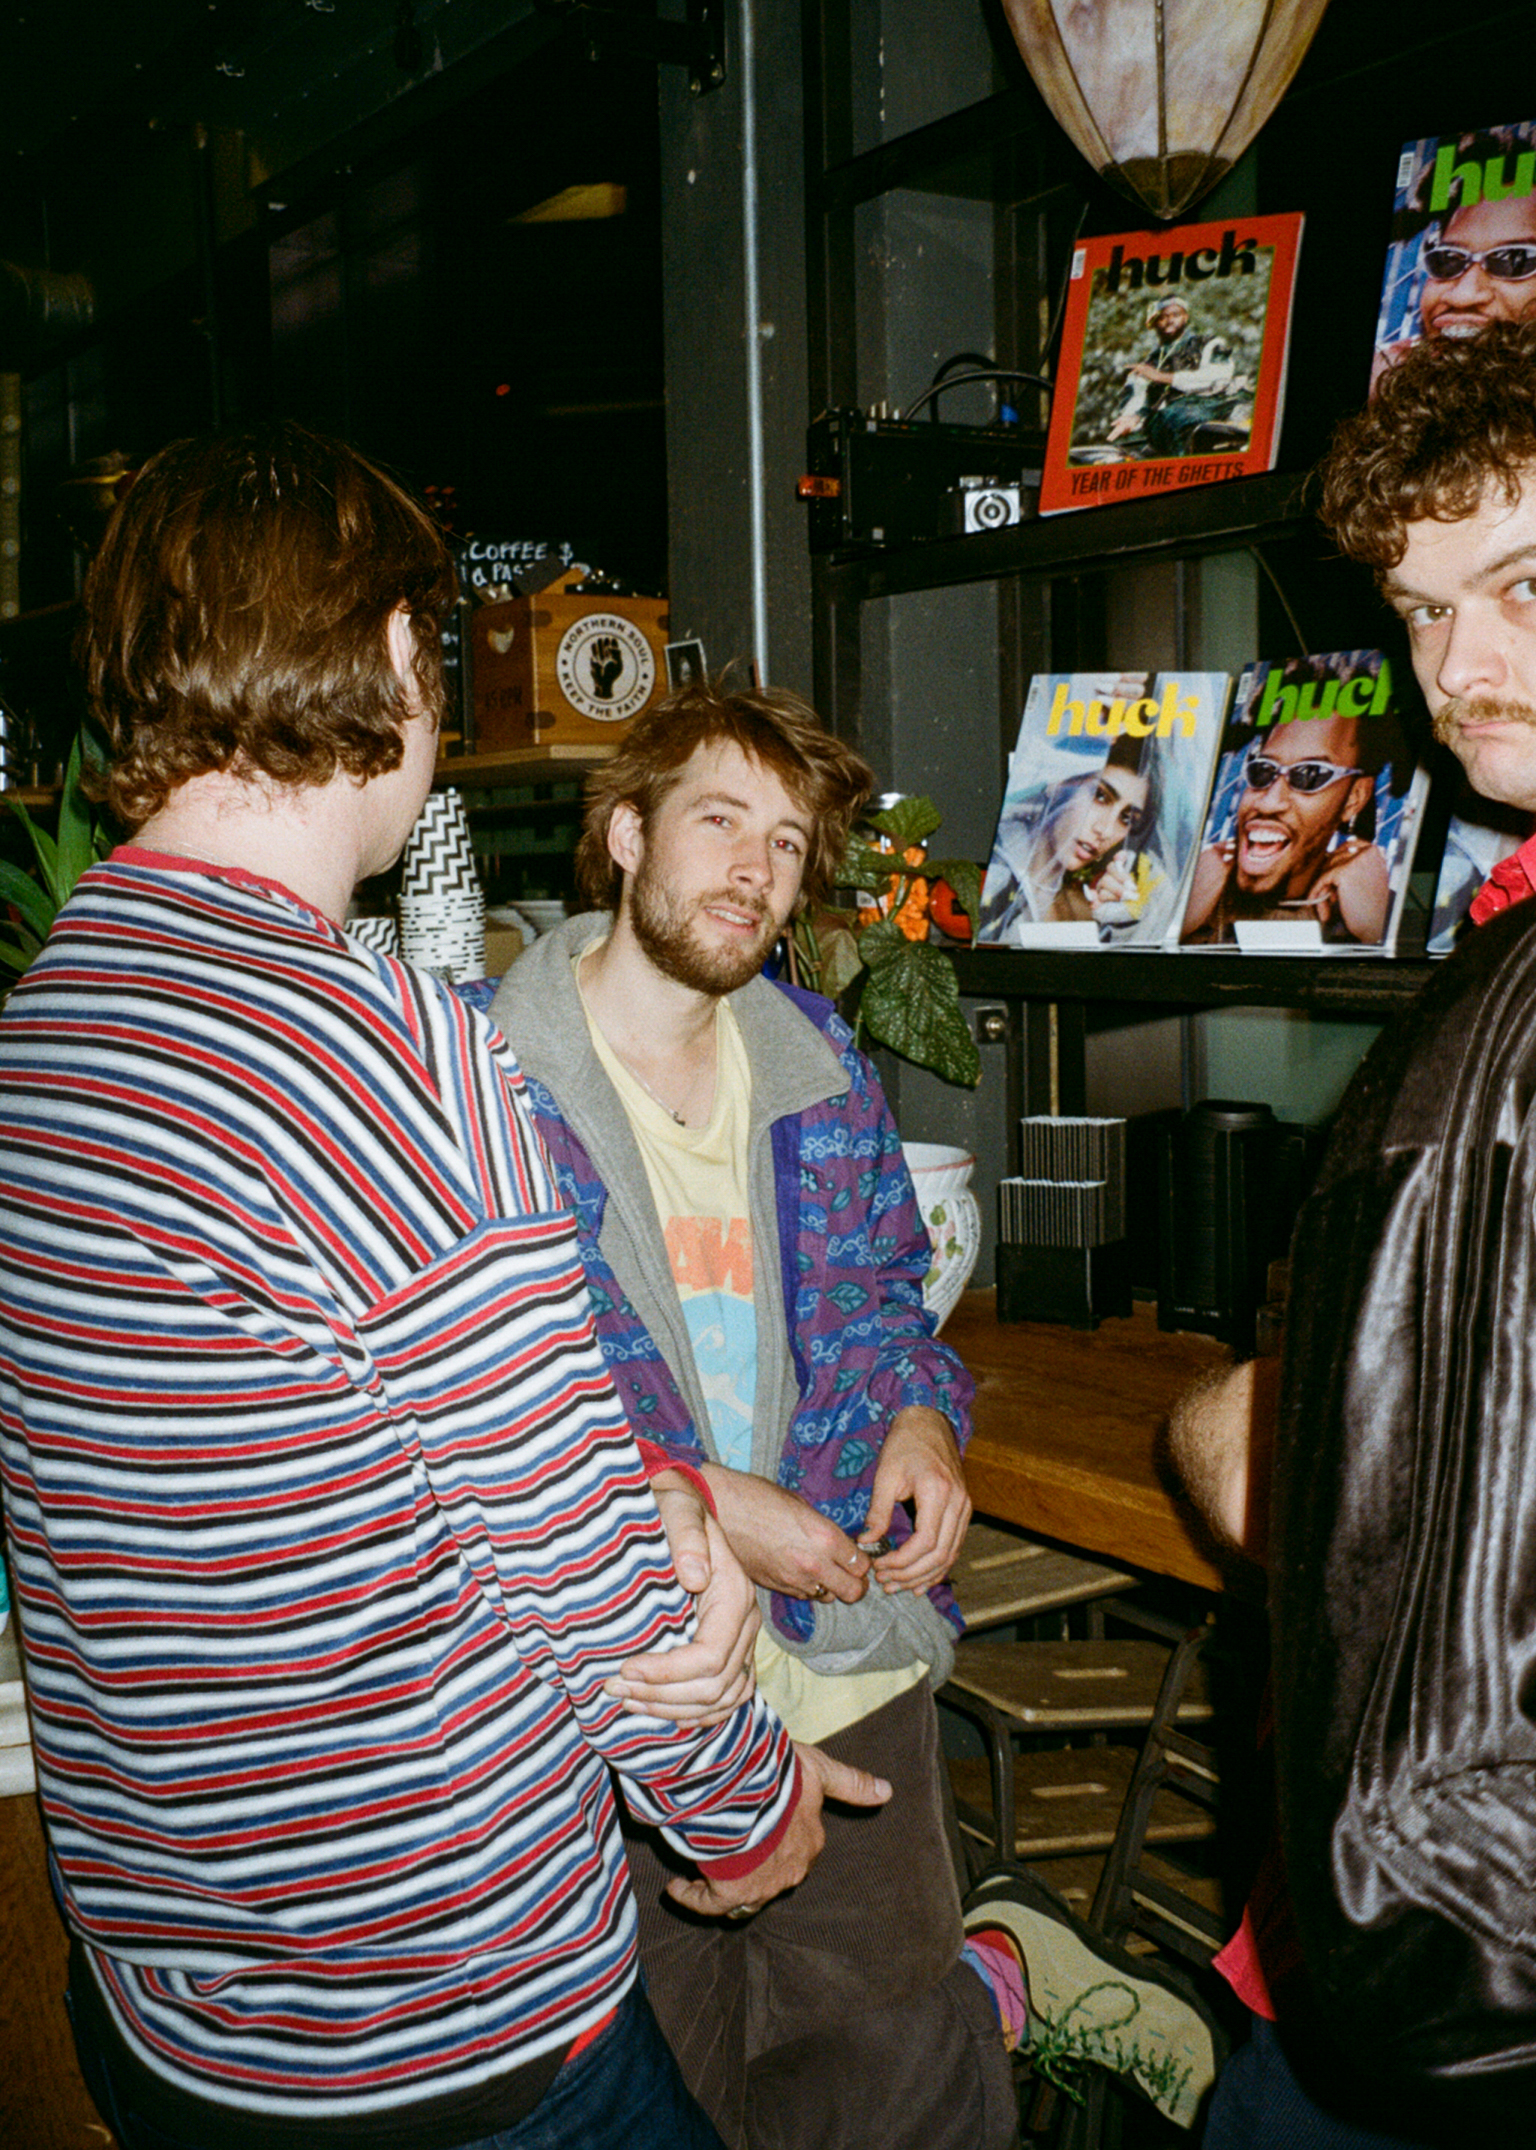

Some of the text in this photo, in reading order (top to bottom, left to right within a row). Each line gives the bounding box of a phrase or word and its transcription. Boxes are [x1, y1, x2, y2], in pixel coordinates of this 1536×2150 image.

[1429, 144, 1536, 212] hu
[1106, 230, 1258, 292] huck
[1071, 461, 1244, 496] YEAR OF THE GHETTS
[469, 541, 548, 560] COFFEE
[563, 618, 650, 665] NORTHERN SOUL
[562, 672, 647, 717] KEEP THE FAITH
[1046, 682, 1199, 738] huck
